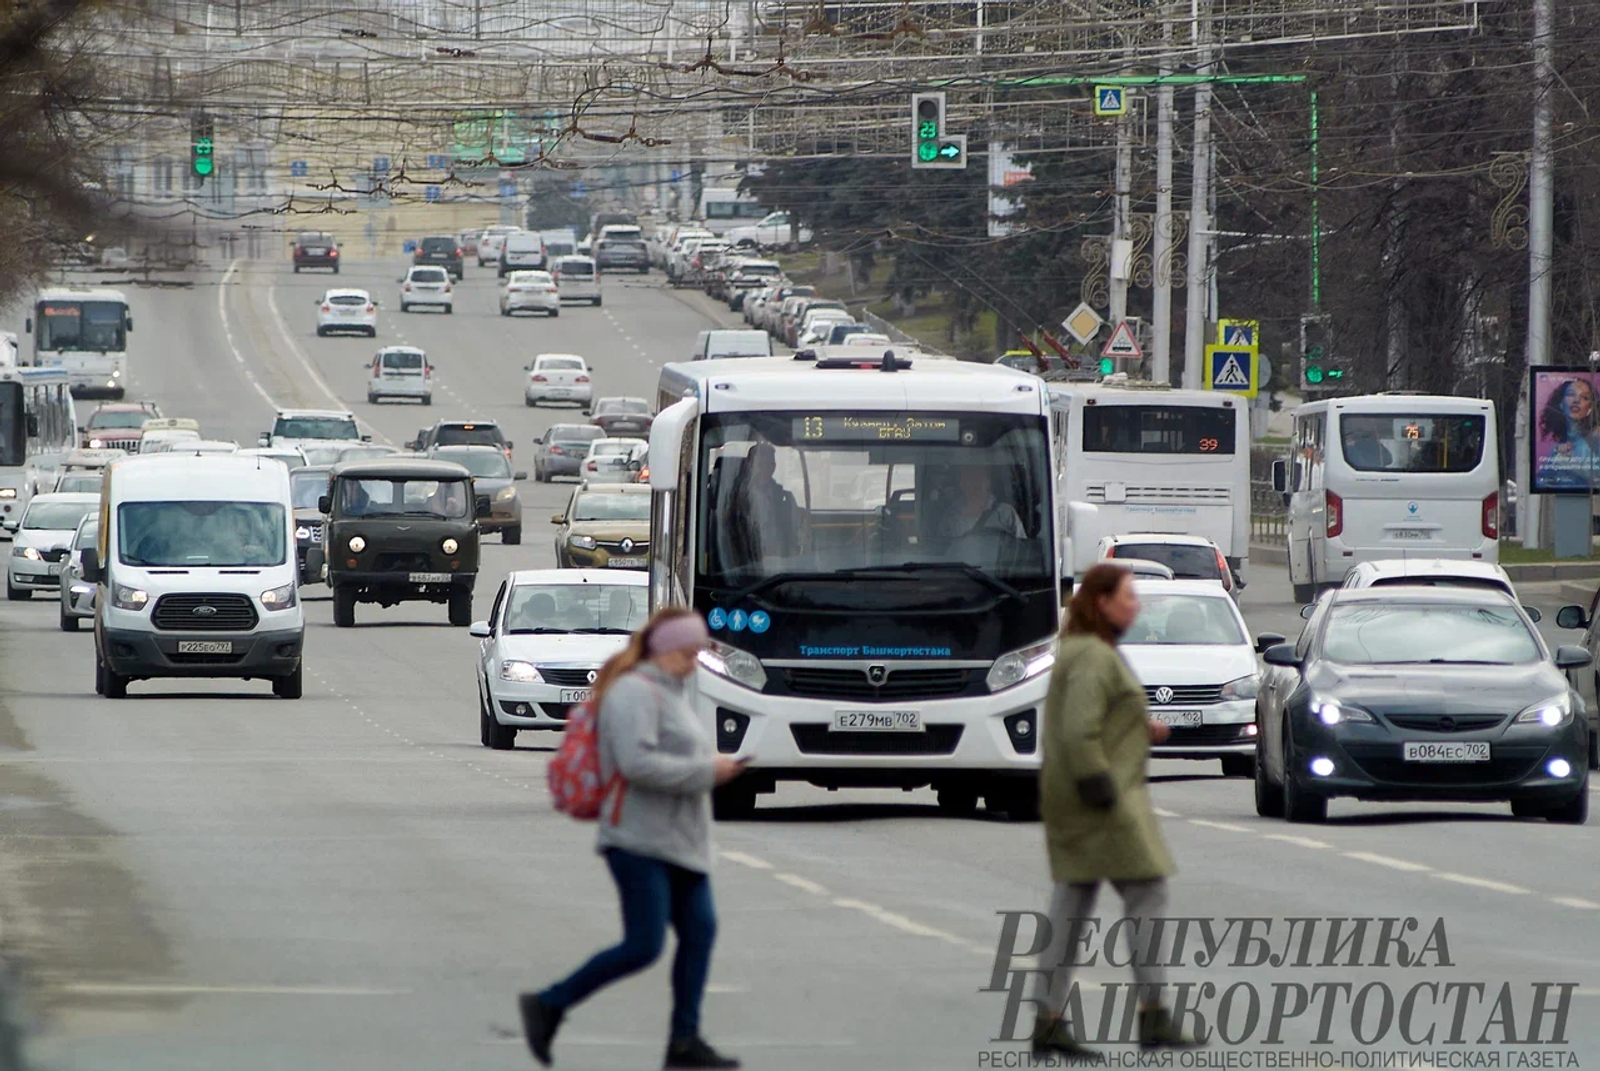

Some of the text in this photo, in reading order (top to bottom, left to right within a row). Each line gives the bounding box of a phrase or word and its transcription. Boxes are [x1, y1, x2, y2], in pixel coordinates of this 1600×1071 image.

[920, 121, 937, 138] 23
[803, 416, 823, 438] 13
[1405, 425, 1418, 439] 75
[1199, 438, 1218, 451] 39
[800, 646, 951, 657] Транспорт Башкортостана
[896, 713, 916, 724] 702
[1409, 744, 1486, 758] В084ЕС 702
